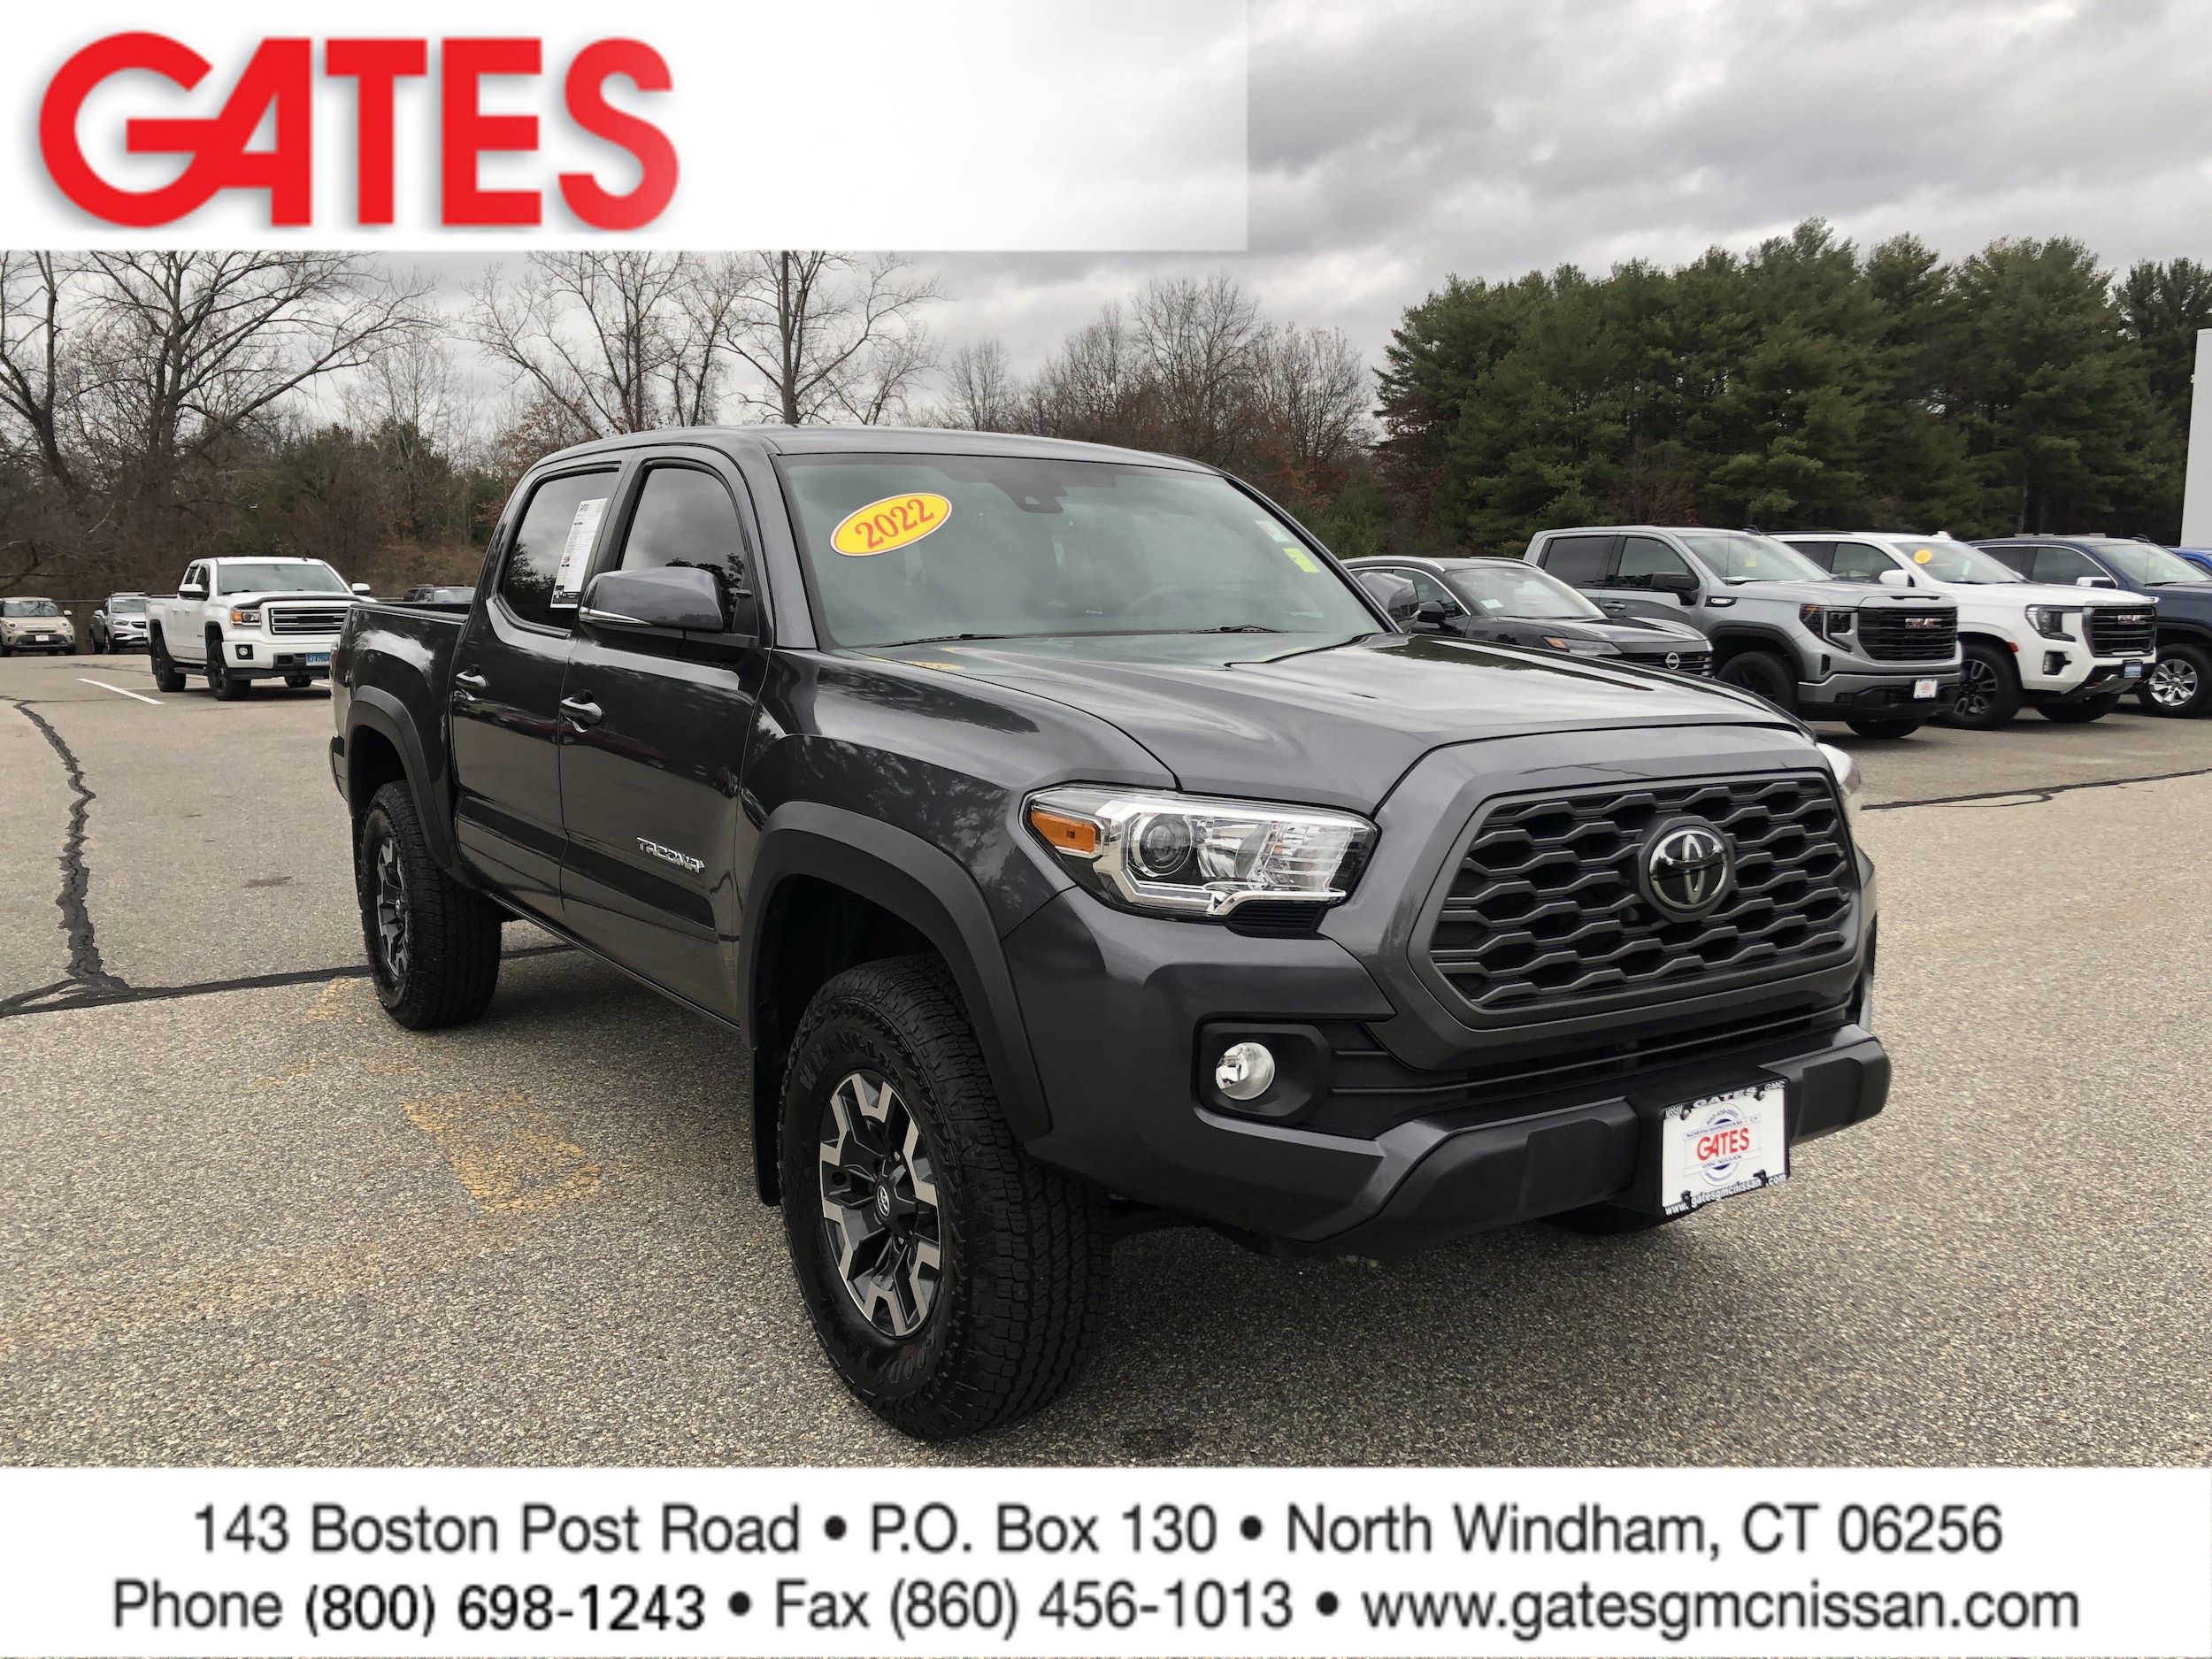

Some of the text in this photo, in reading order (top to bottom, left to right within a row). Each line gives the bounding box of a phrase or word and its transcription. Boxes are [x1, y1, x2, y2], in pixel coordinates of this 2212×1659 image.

[855, 499, 935, 549] 2022
[1905, 618, 1942, 629] GMC
[637, 837, 705, 873] TACOMA
[1693, 1080, 1786, 1108] GATES GMC
[1696, 1127, 1750, 1161] GATES
